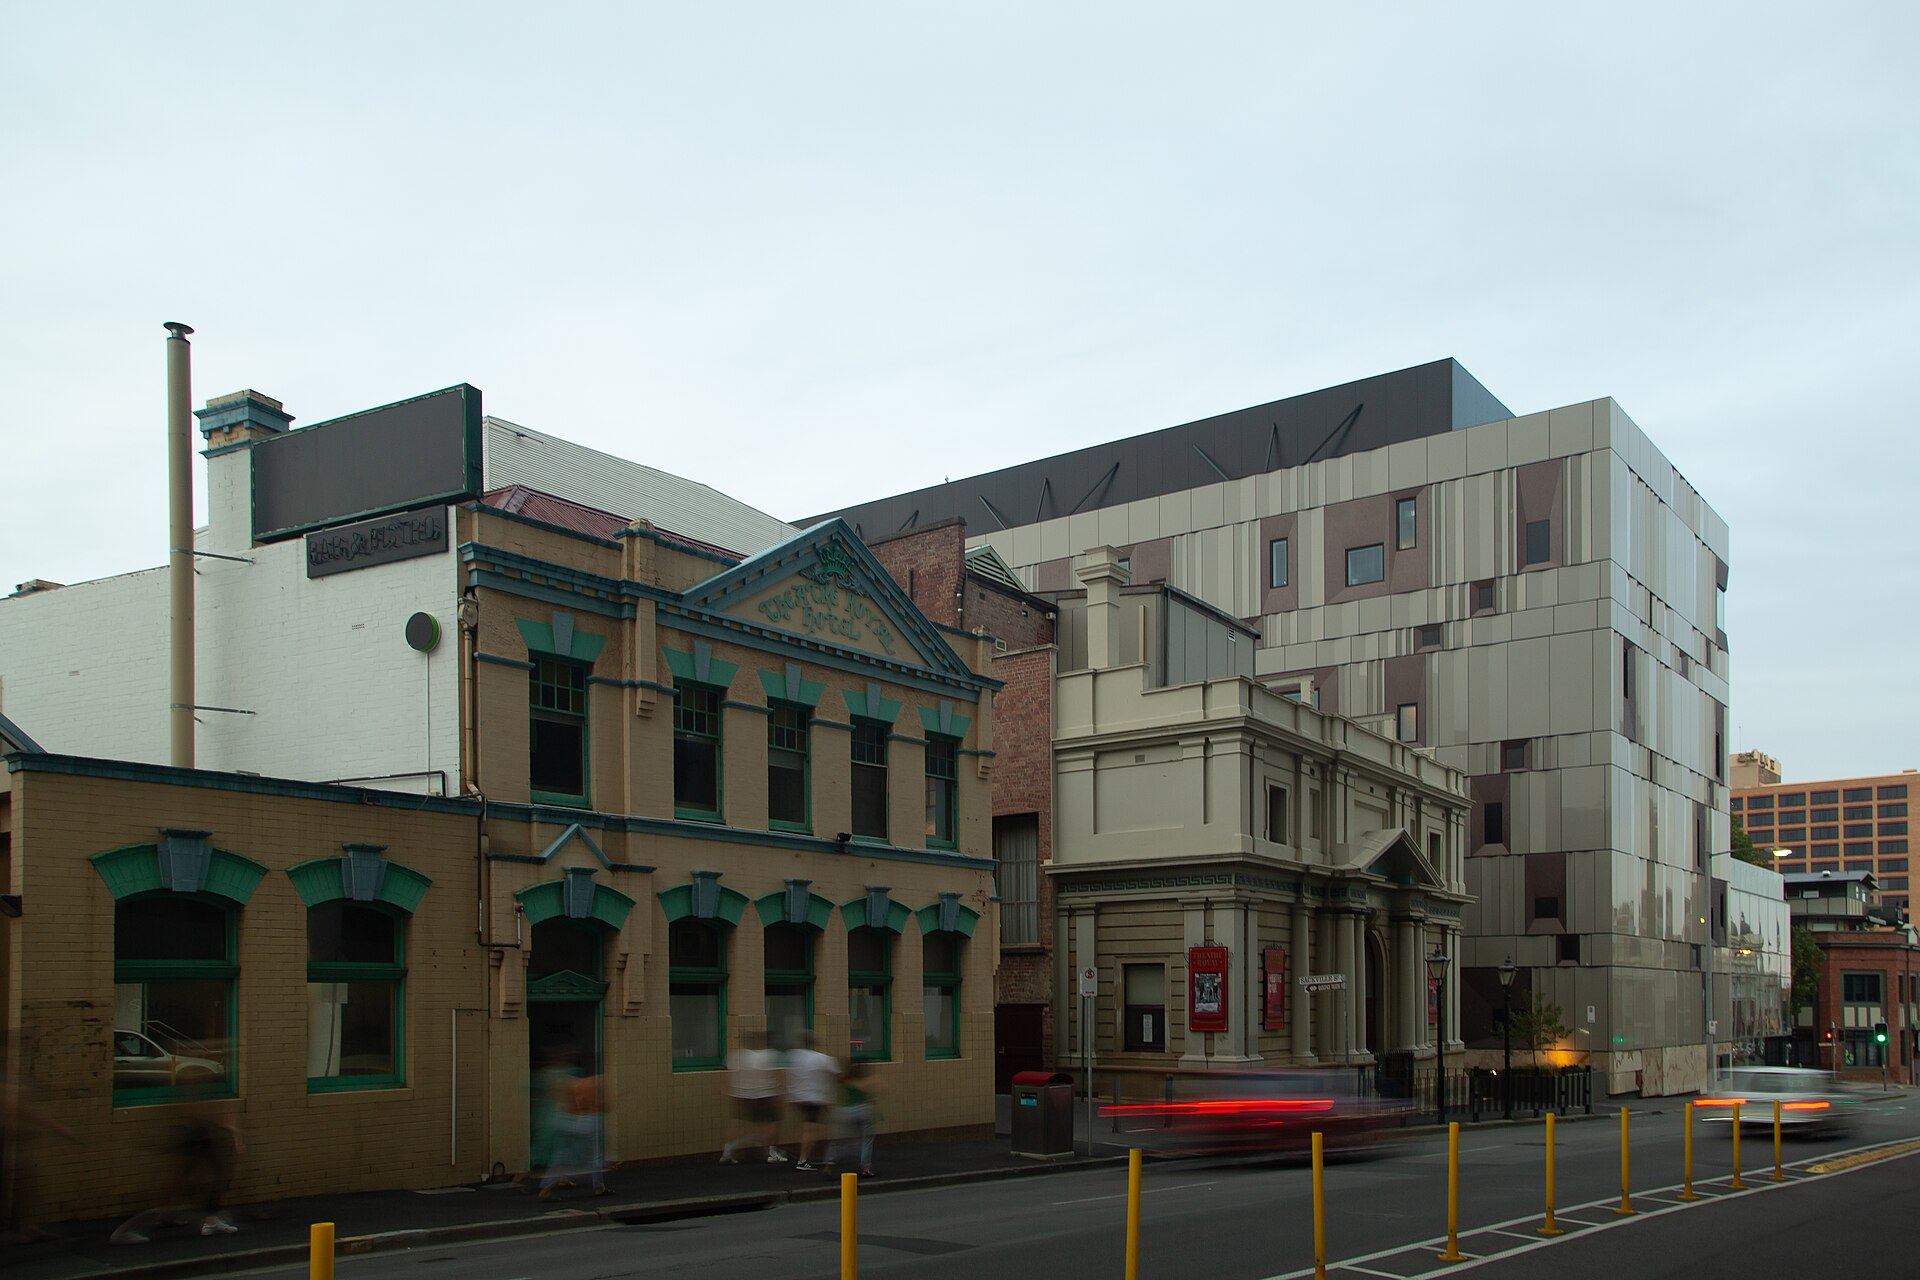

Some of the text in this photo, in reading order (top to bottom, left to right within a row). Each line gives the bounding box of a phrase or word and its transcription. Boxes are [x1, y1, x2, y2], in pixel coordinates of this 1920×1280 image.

[310, 536, 348, 566] BAR
[371, 516, 440, 549] BISTRO
[802, 605, 861, 640] HOTEL
[845, 591, 896, 654] ROYAL
[1196, 959, 1219, 967] ROYAL
[1301, 976, 1333, 984] SACKVILLE
